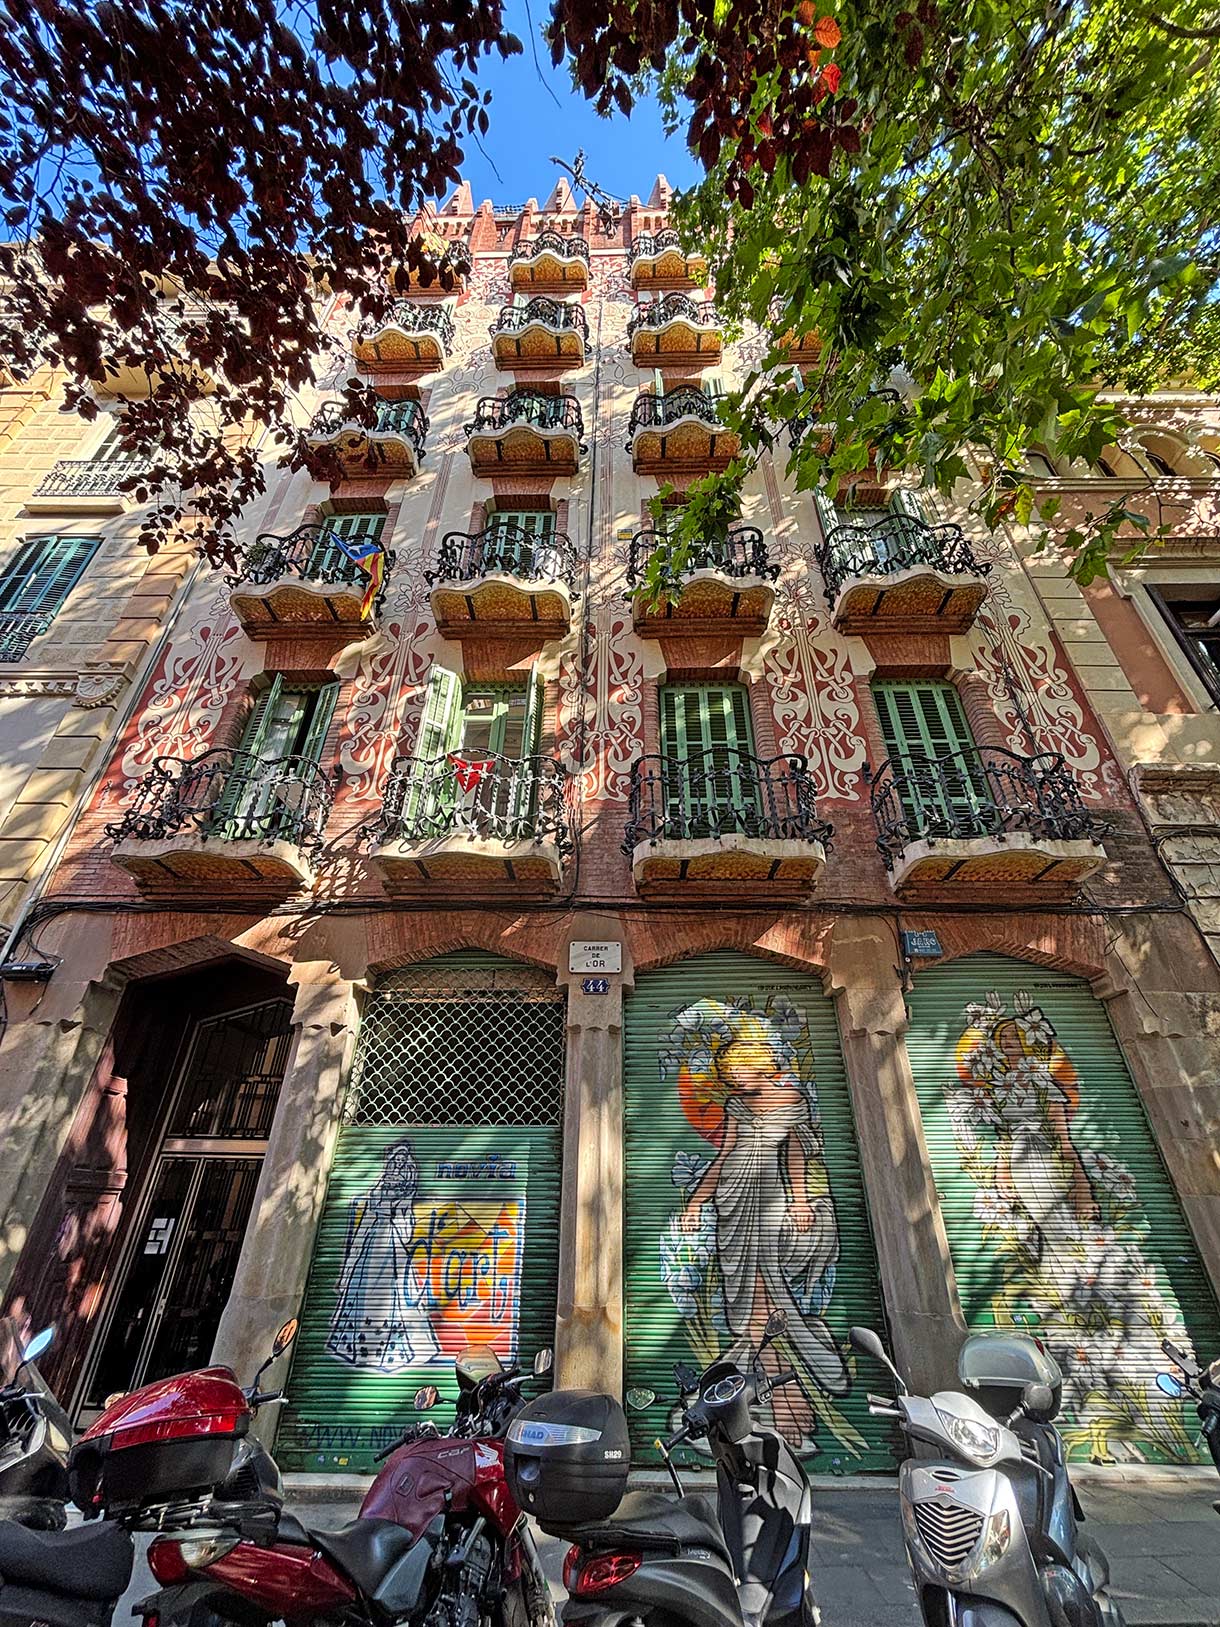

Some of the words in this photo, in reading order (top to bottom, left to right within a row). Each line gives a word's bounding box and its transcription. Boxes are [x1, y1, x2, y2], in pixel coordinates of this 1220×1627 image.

[586, 960, 606, 968] L'OR
[586, 980, 605, 992] 44
[435, 1152, 517, 1180] novia
[604, 1450, 622, 1459] SH29
